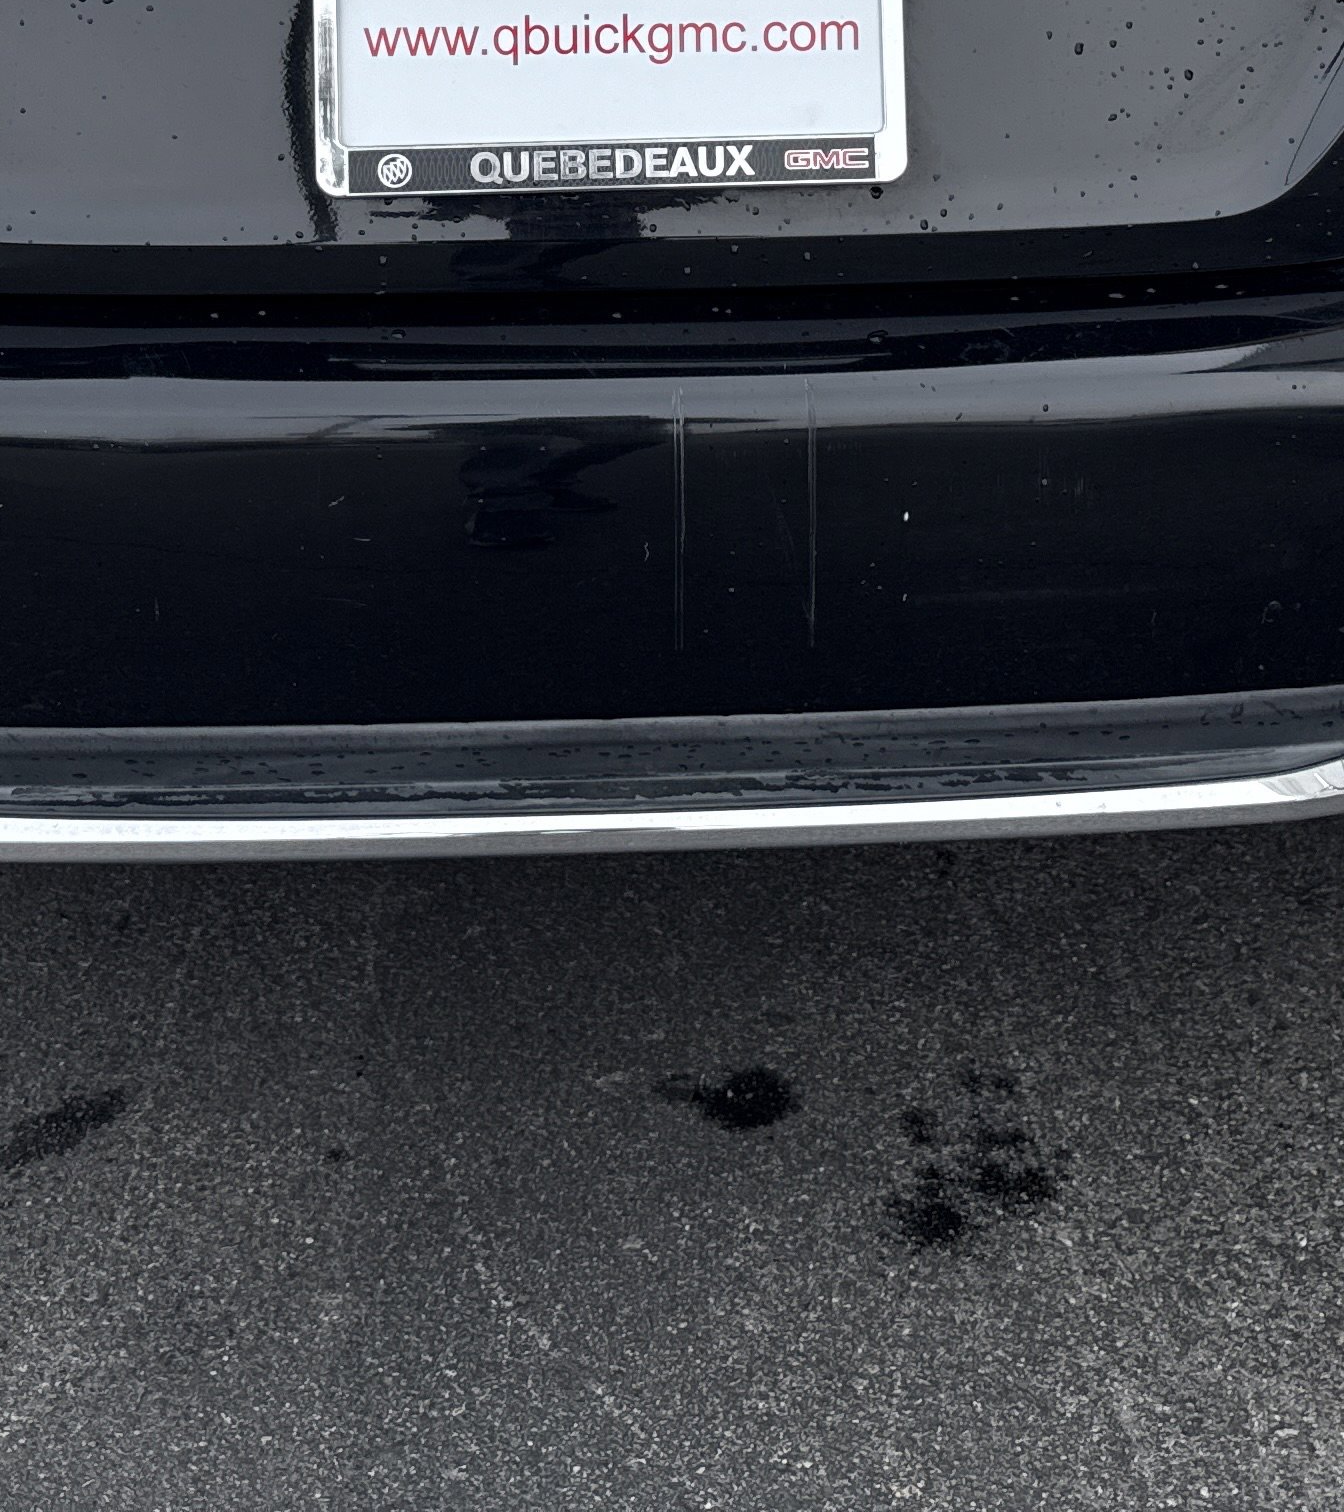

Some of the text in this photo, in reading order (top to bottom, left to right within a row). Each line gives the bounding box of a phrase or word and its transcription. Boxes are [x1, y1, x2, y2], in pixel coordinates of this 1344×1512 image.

[363, 13, 860, 66] www.qbuickgmc.com
[470, 144, 870, 185] QUEBEDEAUX GMC
